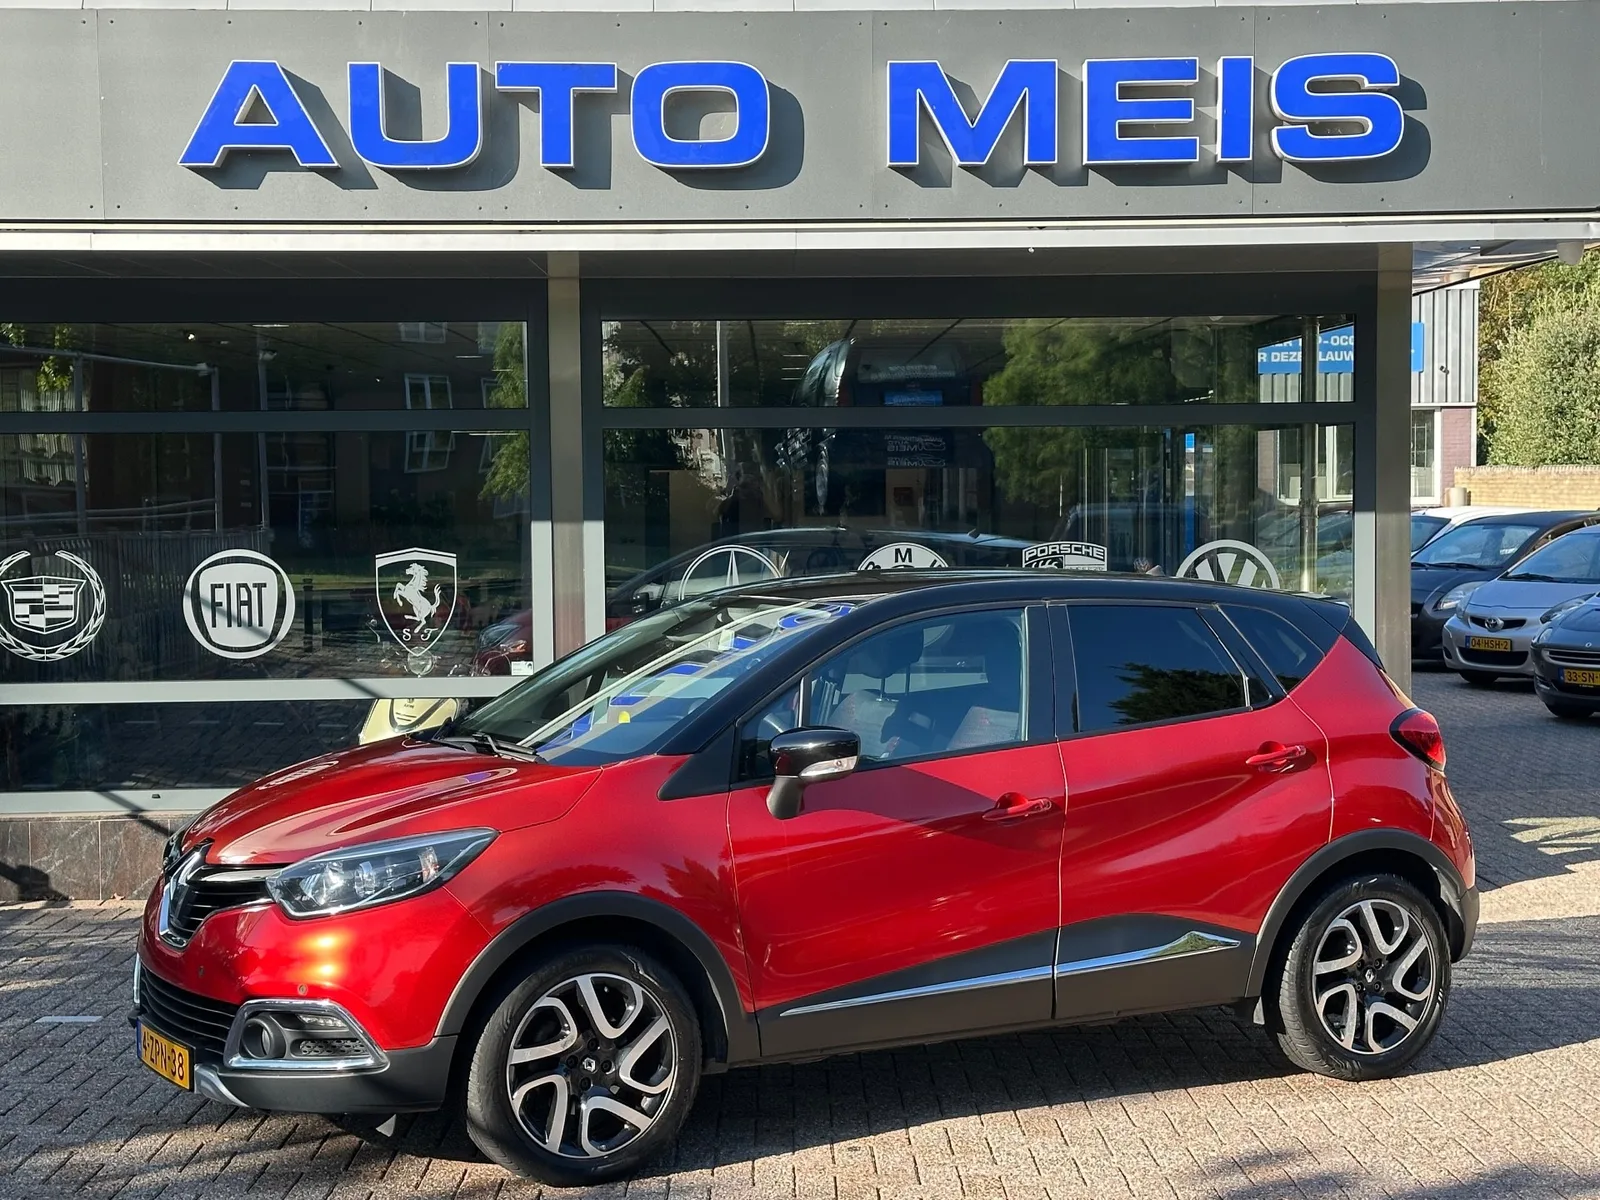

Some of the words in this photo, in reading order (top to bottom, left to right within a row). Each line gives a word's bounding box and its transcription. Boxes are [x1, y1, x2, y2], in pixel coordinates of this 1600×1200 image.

[178, 59, 771, 170] AUTO
[887, 52, 1405, 167] MEIS
[1318, 350, 1354, 361] LAUW
[1026, 543, 1104, 561] PORSCHE
[210, 583, 267, 628] FIAT
[402, 628, 411, 641] S
[142, 1030, 185, 1081] 4-ZPN-38
